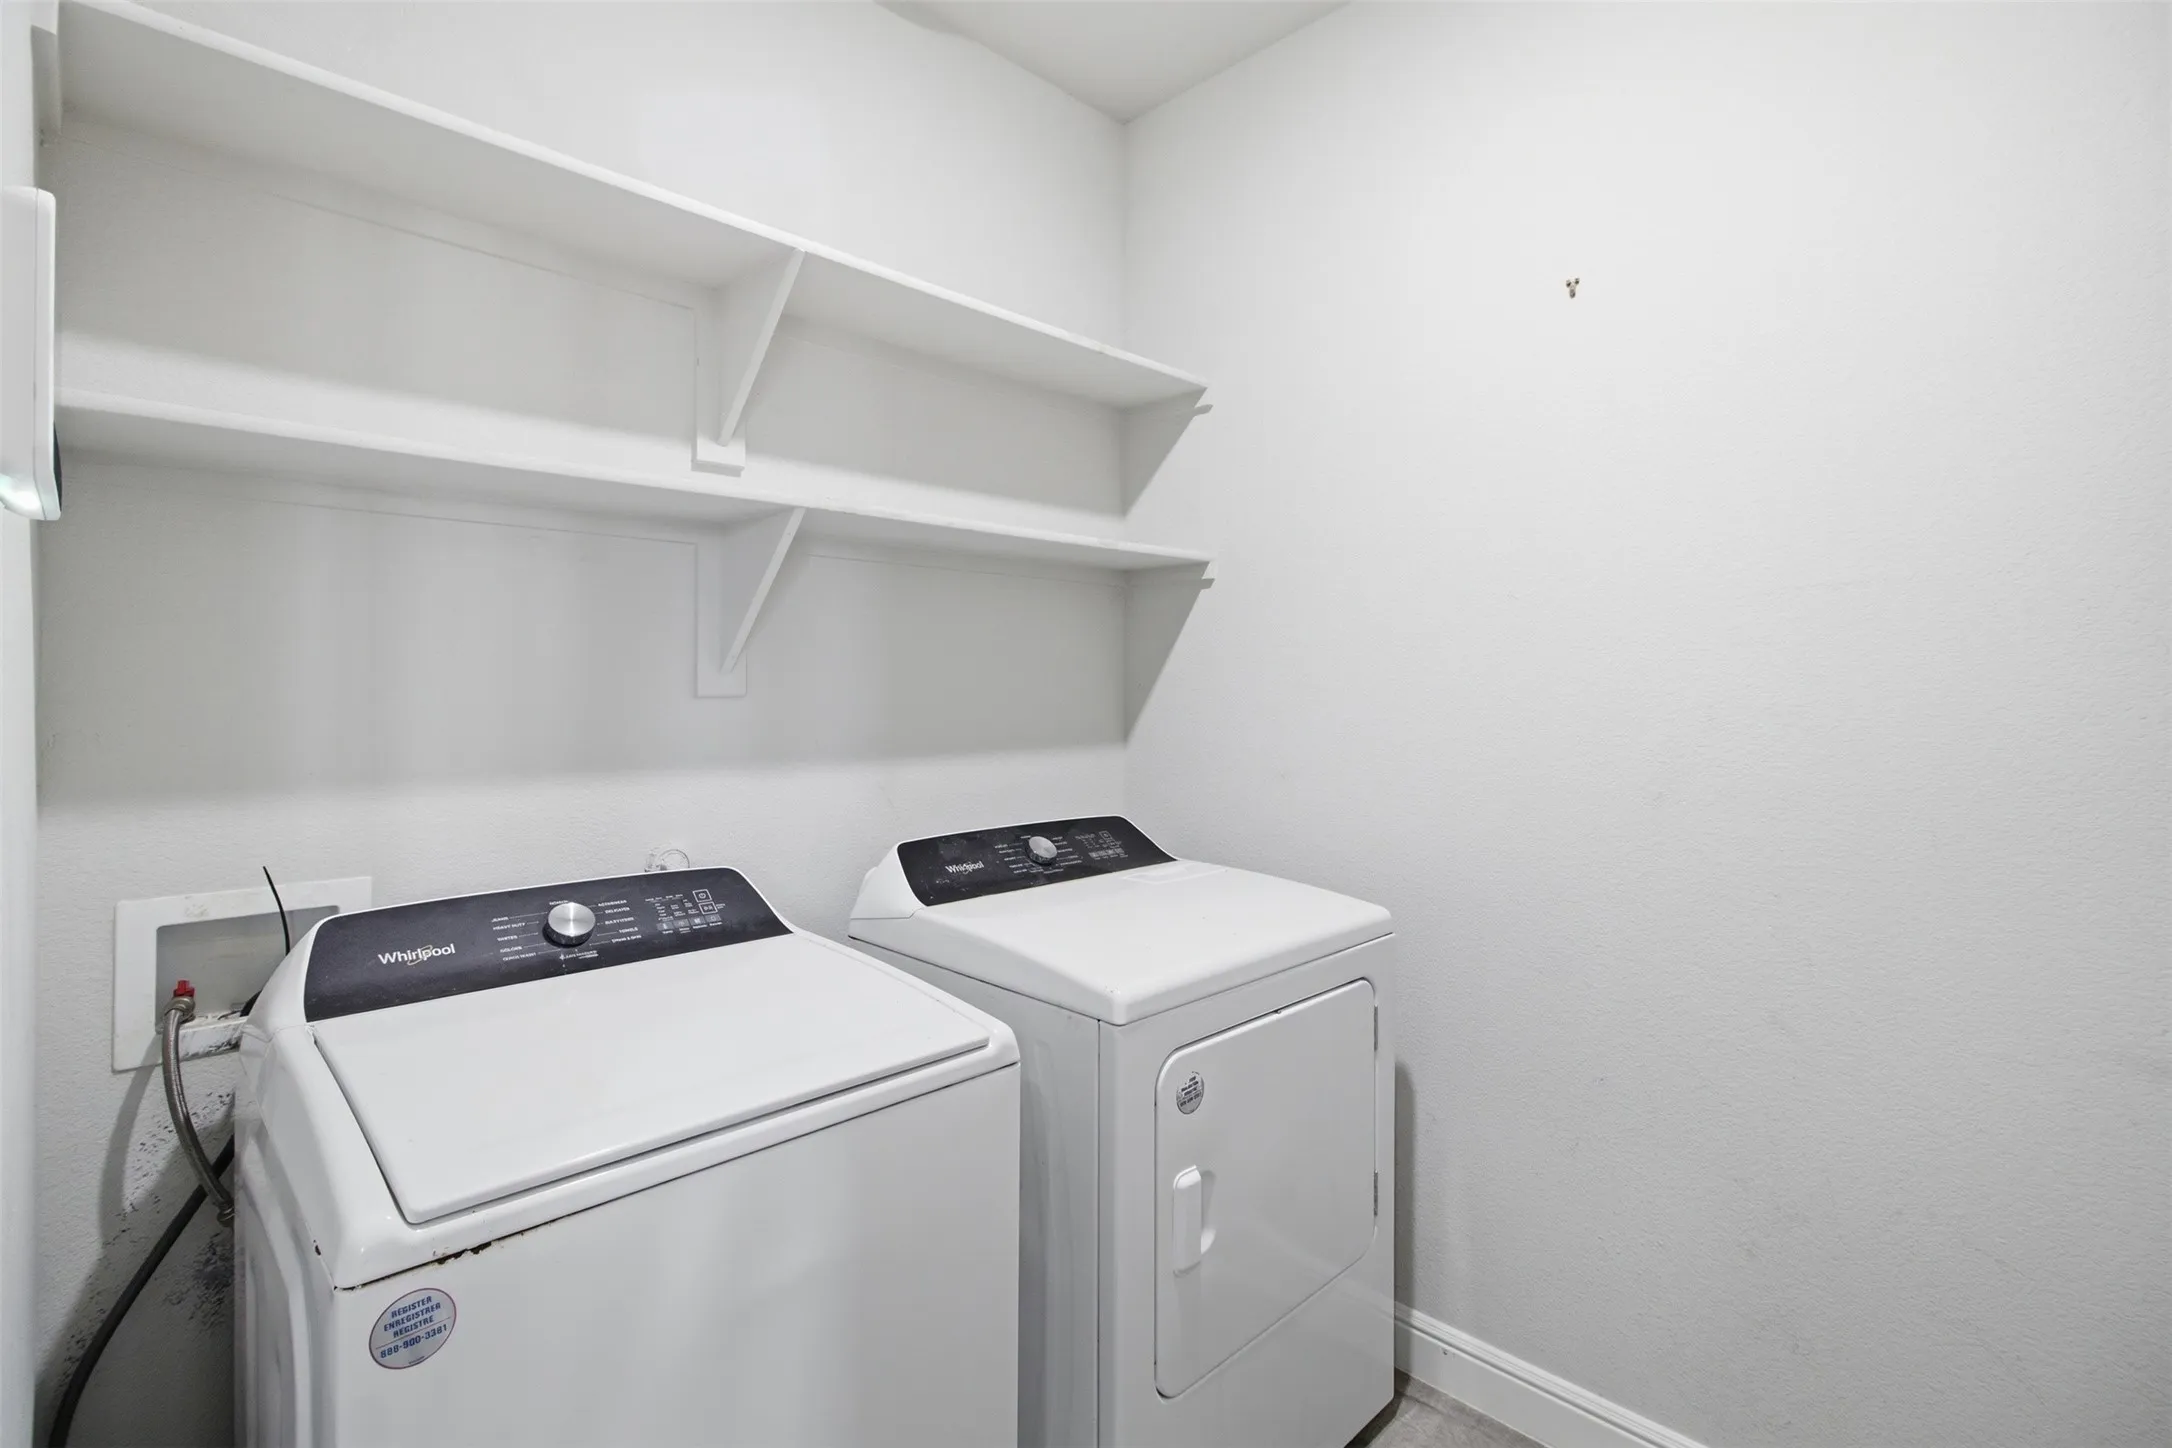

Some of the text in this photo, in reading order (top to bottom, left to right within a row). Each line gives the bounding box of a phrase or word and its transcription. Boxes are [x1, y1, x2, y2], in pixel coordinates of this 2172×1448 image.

[944, 860, 985, 874] Whirlpool
[377, 943, 456, 965] Whirlpool
[384, 1302, 441, 1331] ENREGISTRER
[391, 1296, 432, 1317] REGISTER
[393, 1315, 434, 1338] REGISTRE
[380, 1324, 447, 1358] 888-900-3381
